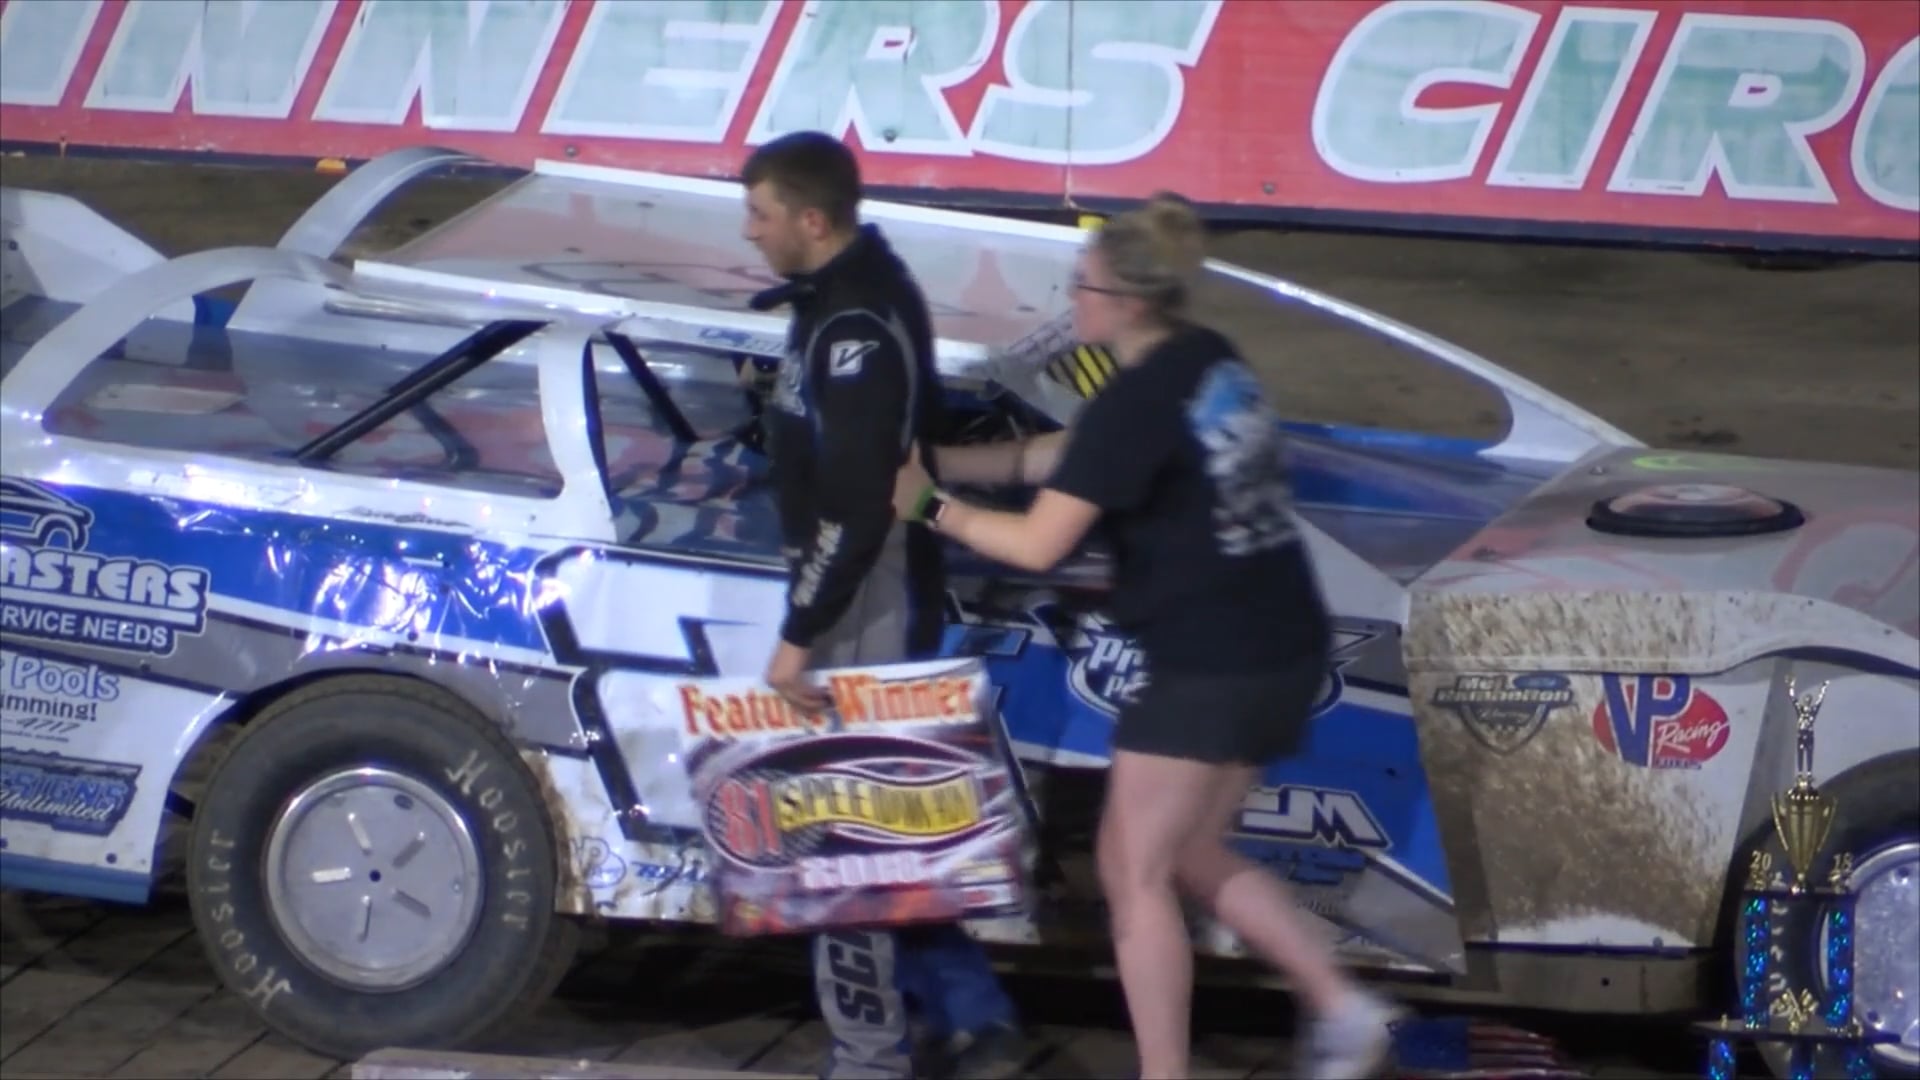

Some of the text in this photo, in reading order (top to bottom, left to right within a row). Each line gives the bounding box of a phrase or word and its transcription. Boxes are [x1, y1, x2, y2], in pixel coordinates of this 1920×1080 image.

[82, 616, 168, 648] NEEDS
[11, 655, 121, 705] Pools
[829, 674, 975, 724] Winner
[1603, 674, 1690, 767] VP
[1656, 718, 1729, 754] Racing
[716, 776, 778, 856] 81
